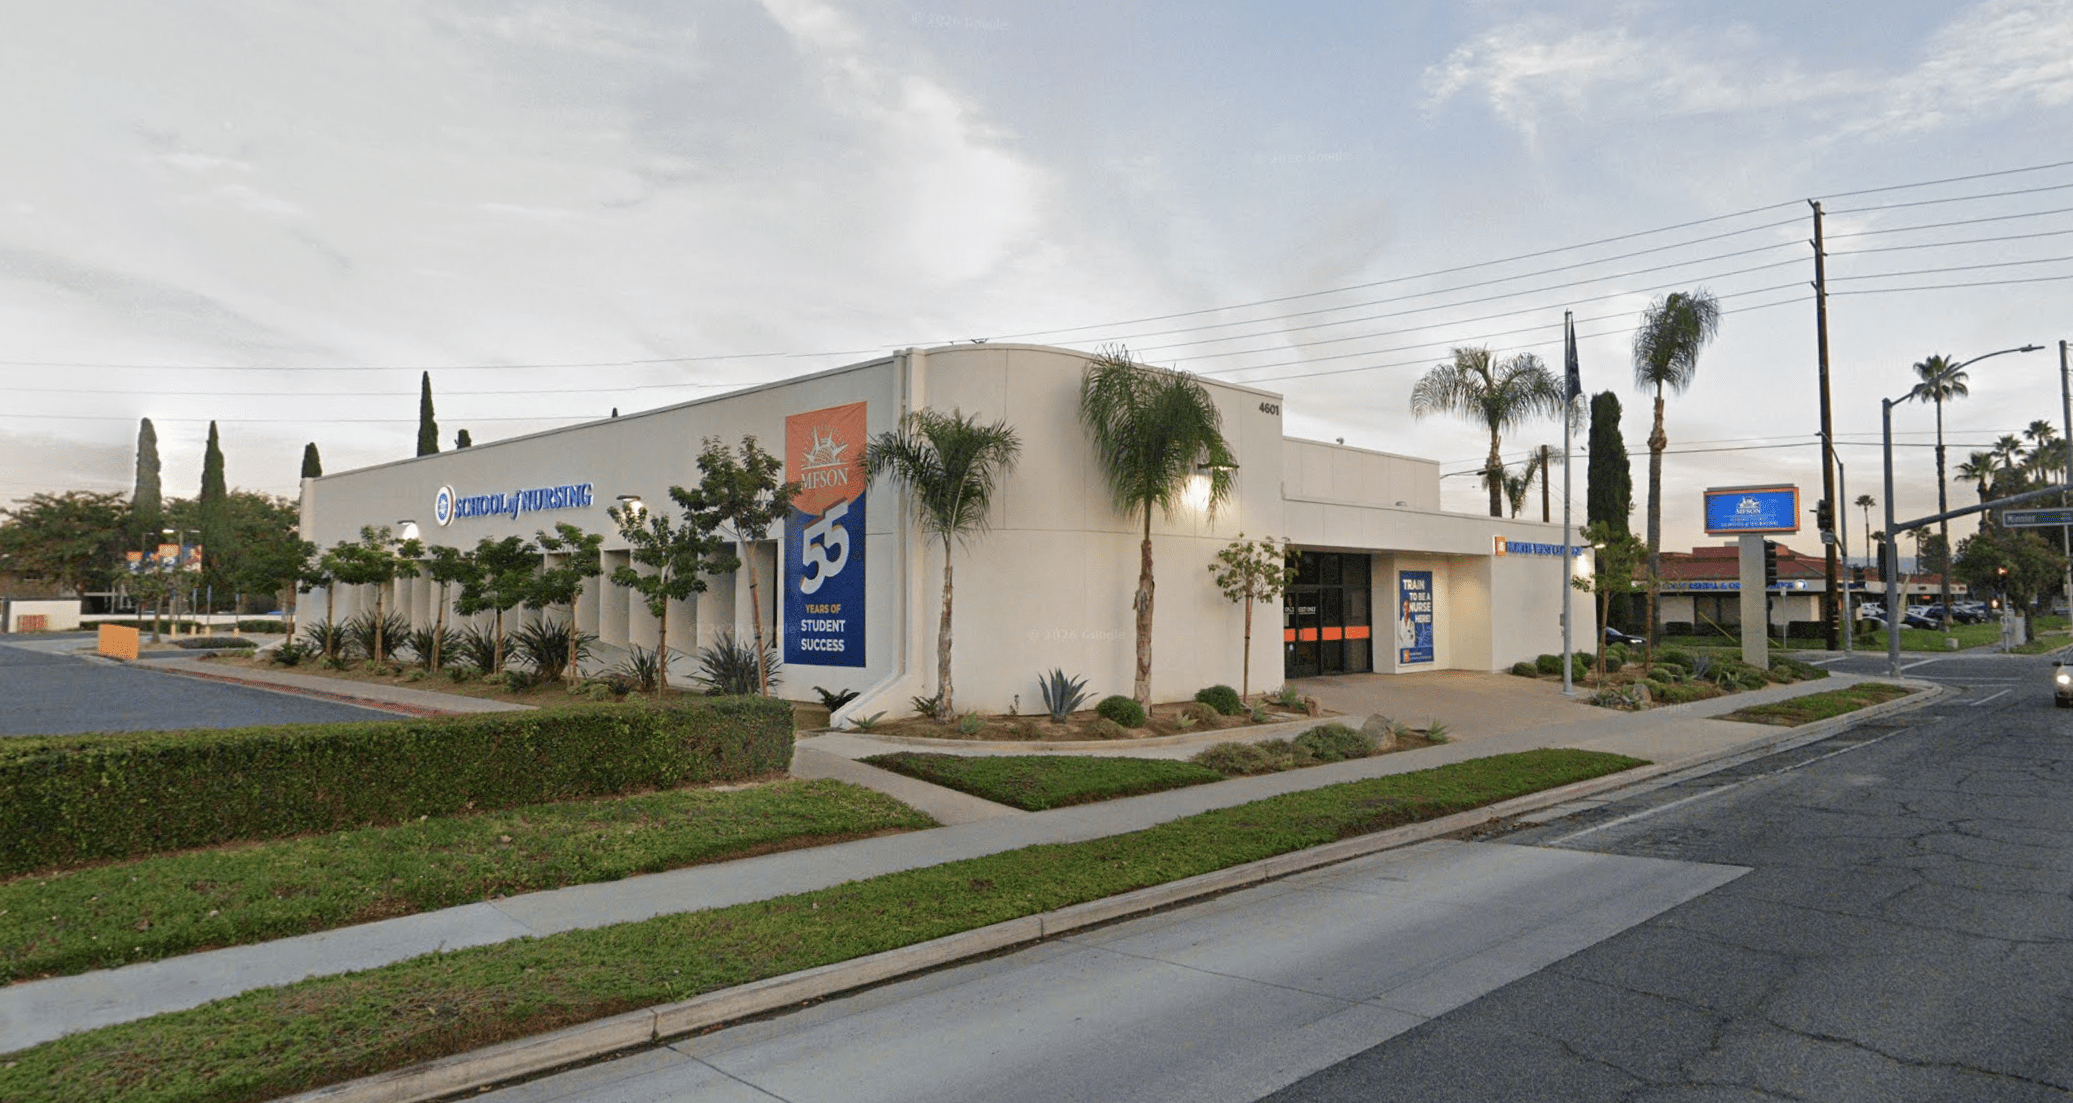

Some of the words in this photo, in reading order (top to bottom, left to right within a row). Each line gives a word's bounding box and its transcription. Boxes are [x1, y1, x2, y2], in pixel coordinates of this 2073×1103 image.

[1259, 402, 1279, 416] 4601
[801, 467, 848, 490] MFSON
[455, 493, 507, 518] SCHOOL
[506, 489, 522, 520] of
[521, 482, 593, 512] NURSING
[800, 499, 850, 595] 55
[1402, 579, 1425, 590] TRAIN
[1409, 592, 1417, 601] TO
[1426, 592, 1431, 601] A
[805, 603, 829, 614] YEARS
[830, 603, 841, 614] OF
[1409, 601, 1432, 612] NURSE
[801, 619, 846, 632] STUDENT
[801, 638, 845, 652] SUCCESS
